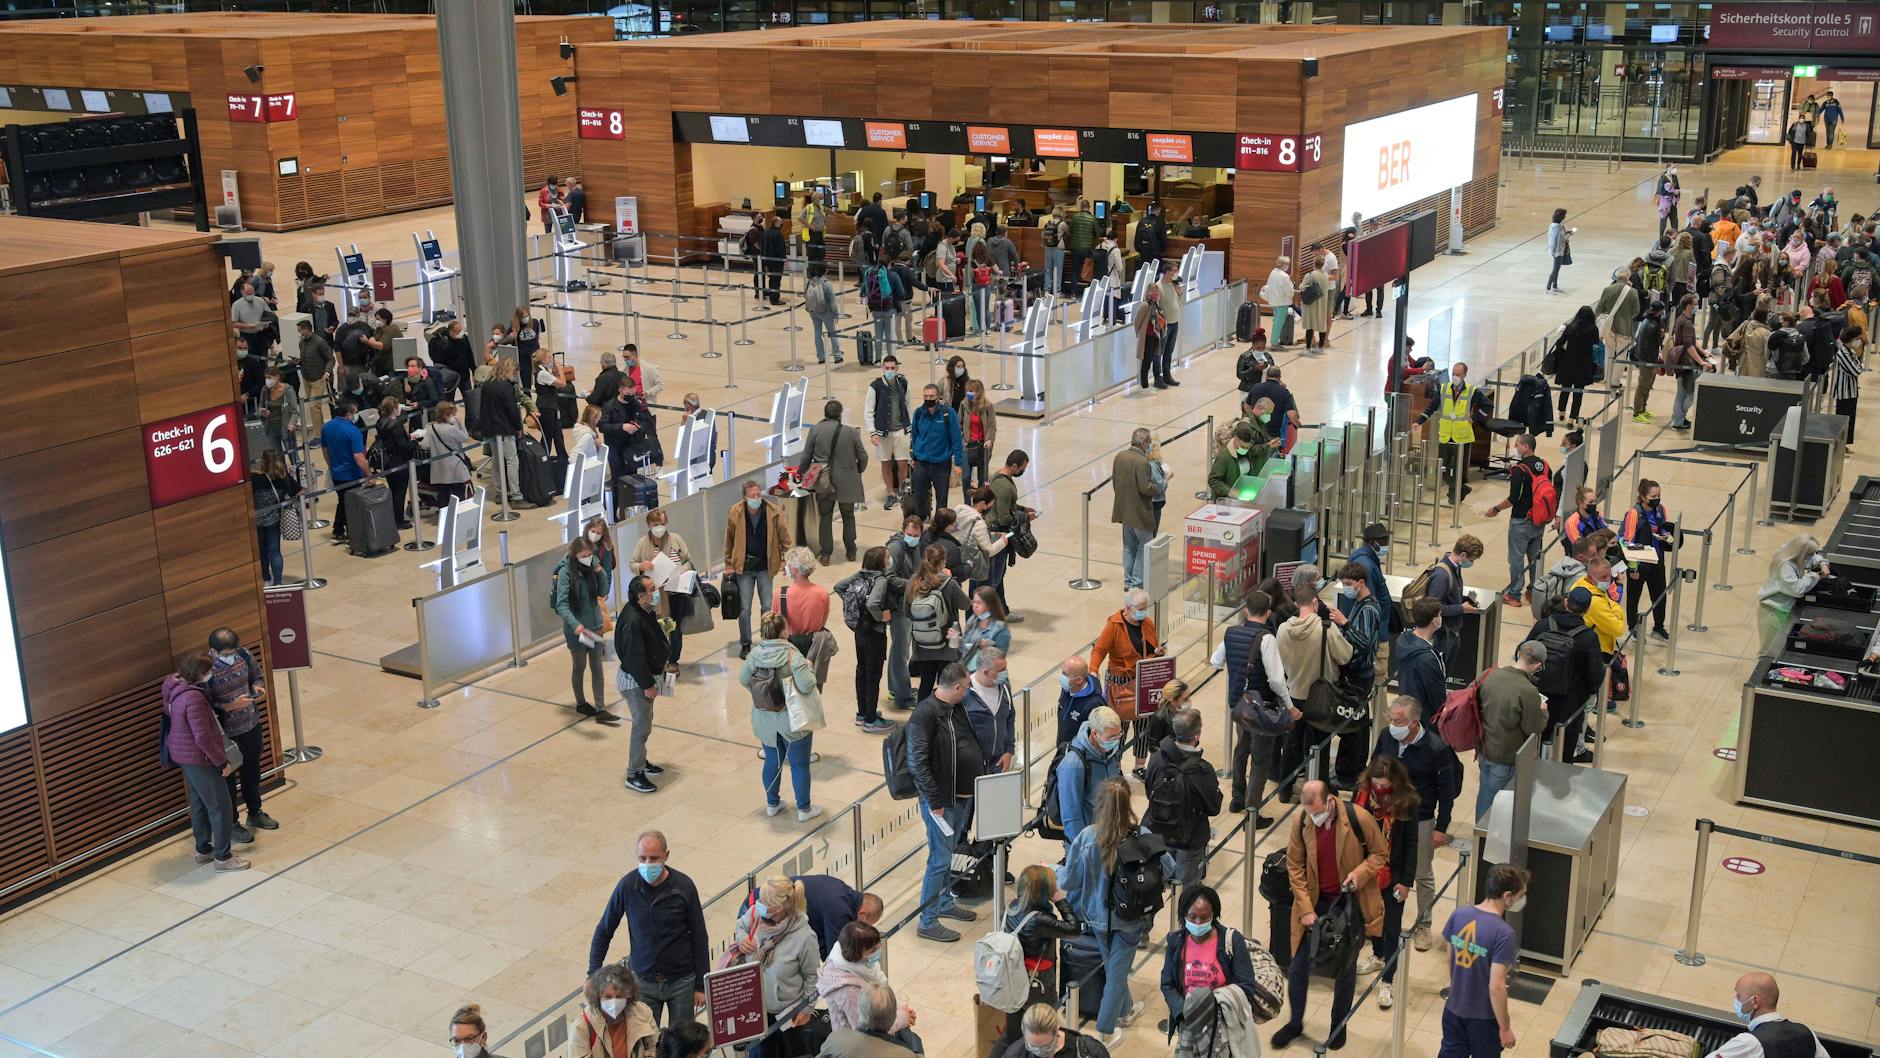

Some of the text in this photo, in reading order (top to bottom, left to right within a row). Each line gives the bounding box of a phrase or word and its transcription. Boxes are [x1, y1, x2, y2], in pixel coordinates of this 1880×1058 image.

[1844, 14, 1851, 25] 5
[1772, 27, 1849, 39] Security Control
[251, 97, 262, 117] 7
[283, 95, 294, 116] 7
[609, 111, 623, 135] 8
[869, 129, 902, 137] CUSTOMER
[1127, 132, 1140, 140] 816
[1241, 137, 1272, 145] Check-in
[1313, 135, 1321, 162] 8
[1278, 138, 1296, 165] 8
[1378, 140, 1411, 190] BER
[1735, 404, 1763, 415] Security
[152, 424, 194, 442] Check-in
[202, 414, 234, 474] 6
[1187, 525, 1203, 534] BER
[1192, 550, 1216, 559] SPENDE
